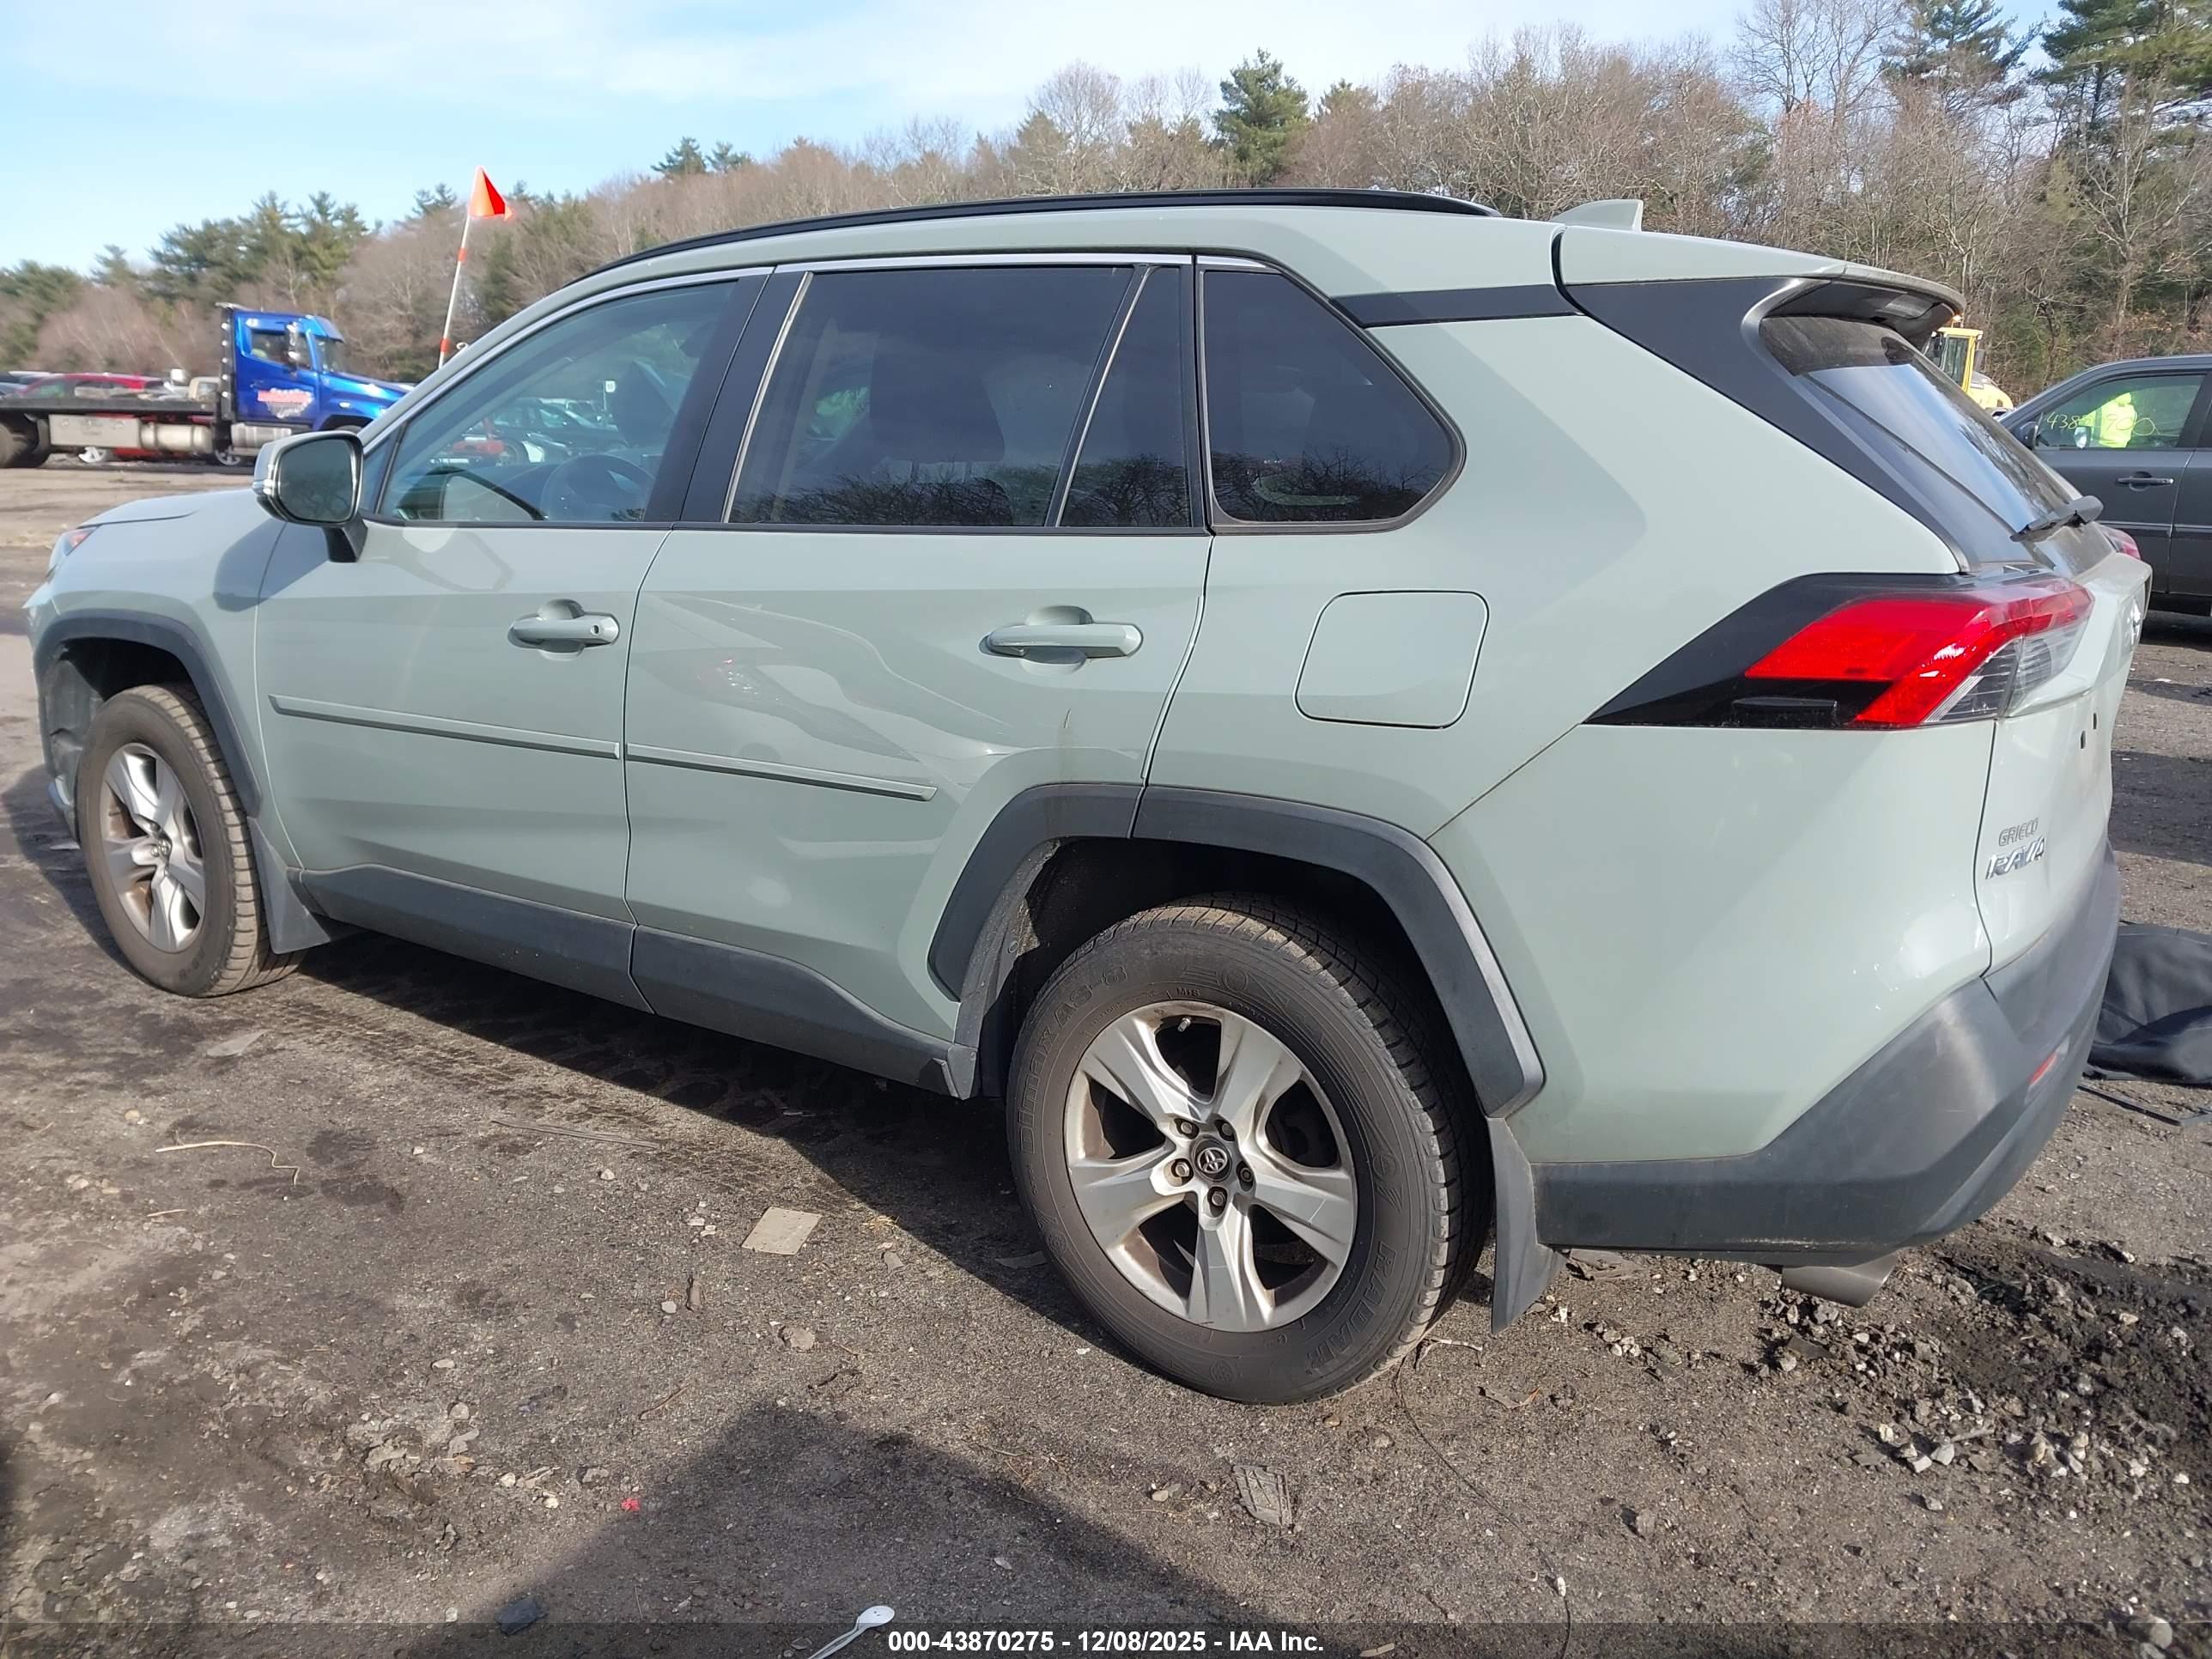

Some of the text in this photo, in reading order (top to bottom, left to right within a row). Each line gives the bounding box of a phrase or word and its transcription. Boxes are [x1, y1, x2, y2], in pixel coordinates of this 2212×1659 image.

[1998, 818, 2039, 846] GRIECO
[1017, 1024, 1059, 1155] Dimax
[1307, 1241, 1396, 1372] RADAR
